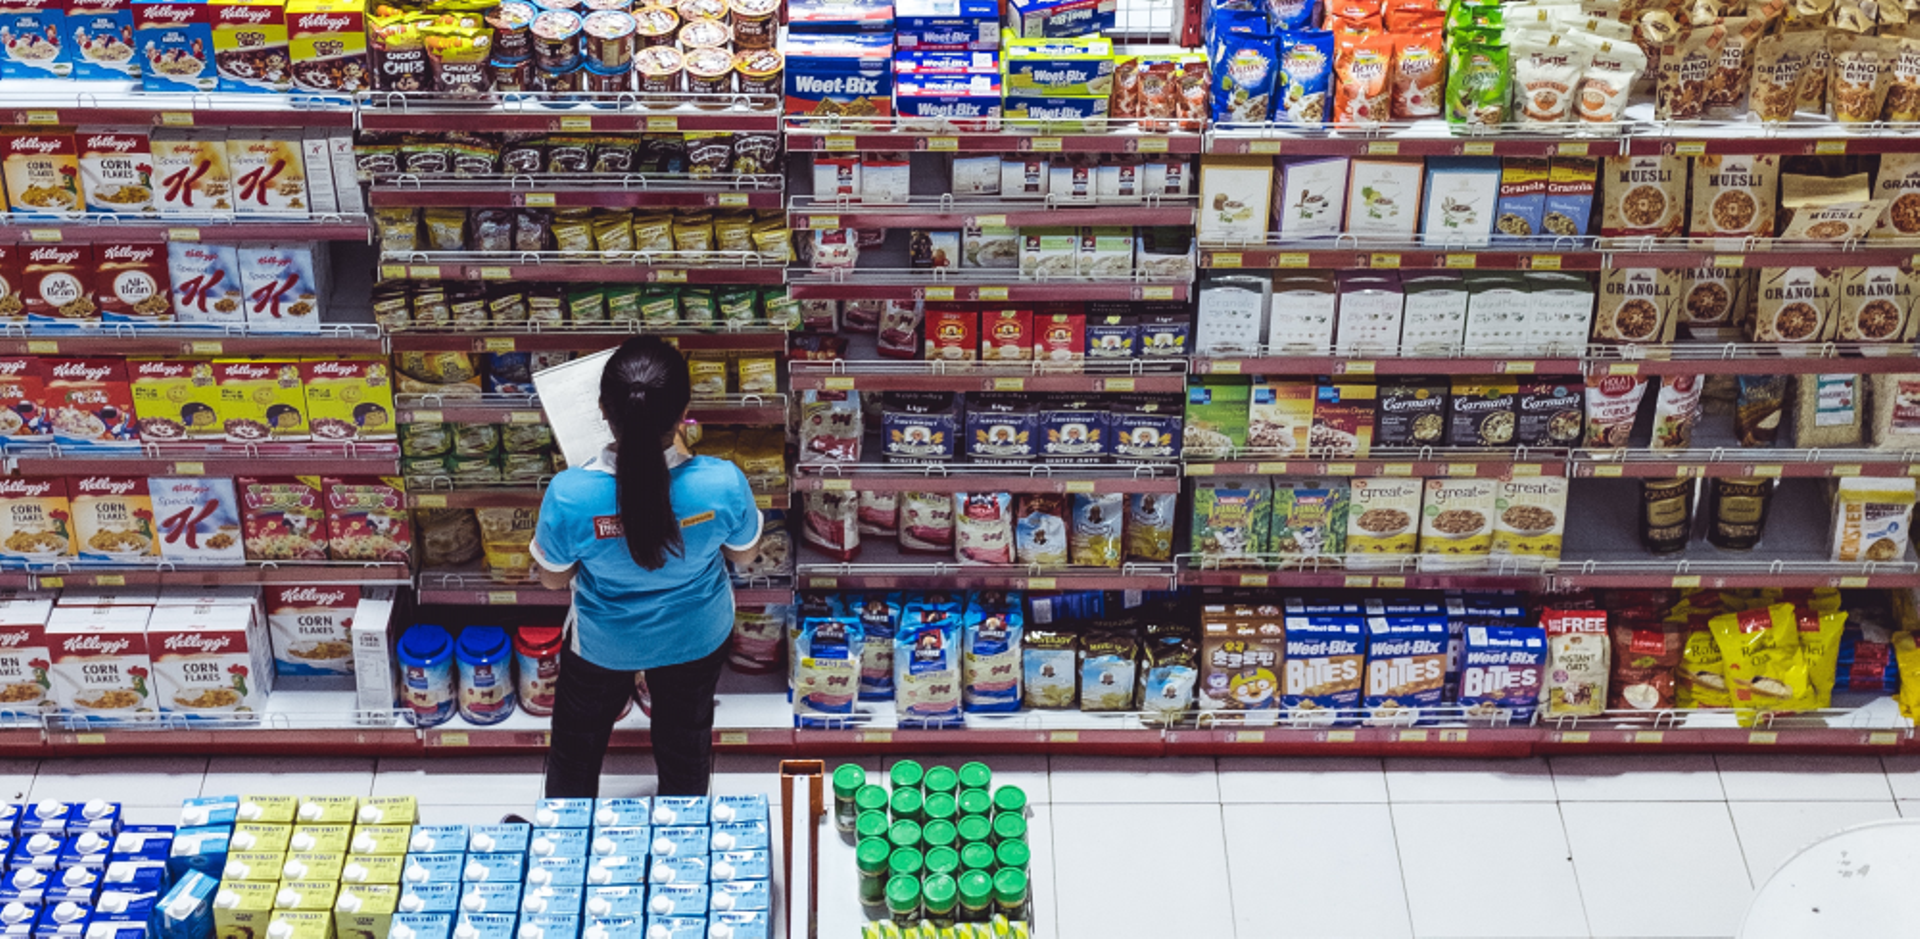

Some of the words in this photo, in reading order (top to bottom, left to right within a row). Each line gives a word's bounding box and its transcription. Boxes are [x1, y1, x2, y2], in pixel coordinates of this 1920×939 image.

[143, 5, 195, 21] Kellogg's
[220, 7, 272, 22] Kellogg's
[298, 15, 350, 30] Kellogg's
[923, 31, 972, 43] Weet-Bix
[383, 61, 425, 75] CHIPS
[441, 72, 482, 84] CHIPS
[1033, 69, 1088, 83] Weet-Bix
[796, 76, 880, 94] Weet-Bix
[917, 102, 981, 116] Weet-Bix
[11, 136, 61, 152] Kellogg's
[87, 135, 138, 151] Kellogg's
[101, 160, 132, 169] CORN
[162, 158, 211, 207] K
[237, 159, 286, 206] K
[1620, 170, 1672, 182] MUESLI
[1709, 174, 1763, 187] MUESLI
[1501, 181, 1545, 195] Granola
[1548, 182, 1593, 193] Granola
[1882, 179, 1920, 190] GRAN
[30, 247, 79, 263] Kellogg's
[105, 245, 154, 261] Kellogg's
[179, 269, 225, 313] K
[252, 273, 299, 318] K
[1606, 283, 1671, 296] GRANOLA
[1764, 287, 1830, 300] GRANOLA
[1846, 283, 1911, 296] GRANOLA
[54, 362, 111, 379] Kellogg's
[139, 364, 183, 375] Kellogg's
[226, 364, 269, 376] Kellogg's
[314, 362, 357, 375] Kellogg's
[1383, 397, 1442, 412] Carman's
[1454, 397, 1513, 412] Carman's
[1521, 397, 1581, 410] Carman's
[79, 477, 135, 494] Kellogg's
[1505, 482, 1547, 497] great
[1360, 486, 1402, 502] great
[1436, 487, 1478, 504] great
[11, 504, 42, 514] CORN
[95, 502, 127, 513] CORN
[162, 497, 219, 549] K
[281, 587, 345, 605] Kellogg's
[298, 616, 333, 626] CORN
[1562, 618, 1606, 632] FREE
[299, 626, 334, 634] FLAKES
[63, 634, 129, 653] Kellogg's
[164, 633, 230, 651] Kellogg's
[1287, 641, 1358, 655] Weet-Bix
[1371, 640, 1441, 655] Weet-Bix
[1467, 651, 1538, 664] Weet-Bix
[1558, 654, 1596, 662] INSTANT
[82, 664, 118, 674] CORN
[183, 663, 219, 674] CORN
[1566, 663, 1590, 671] OATS
